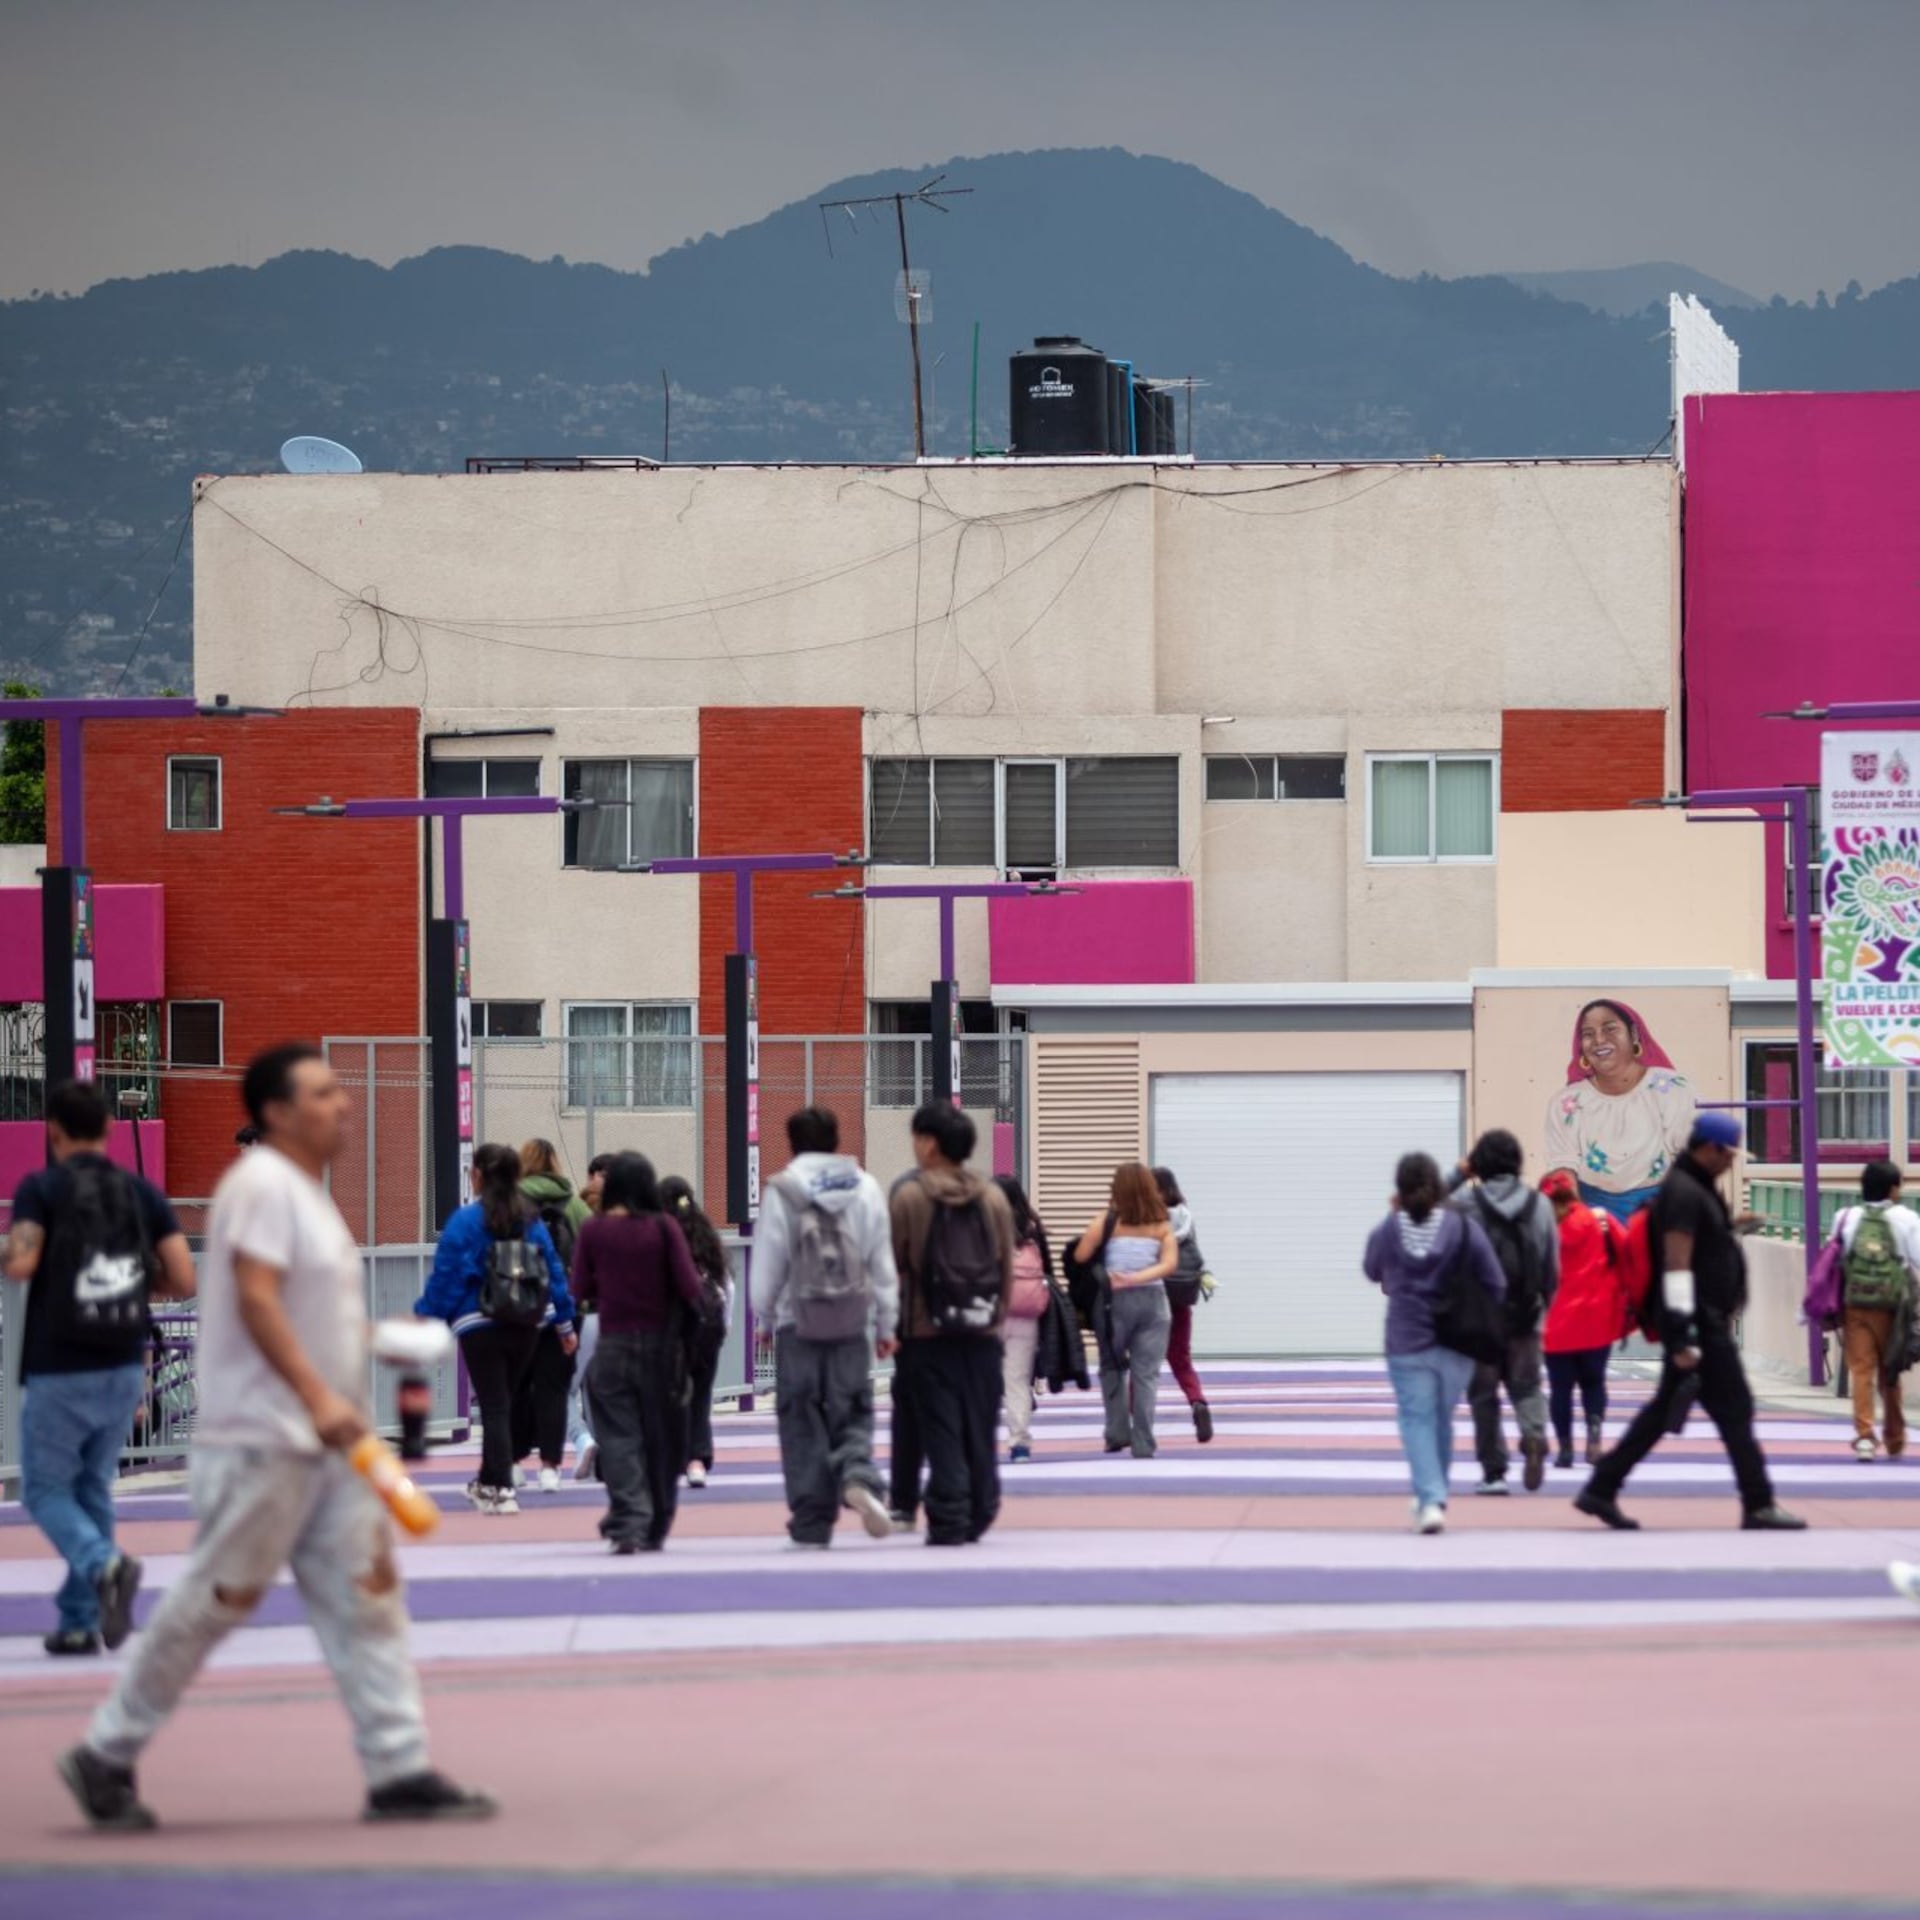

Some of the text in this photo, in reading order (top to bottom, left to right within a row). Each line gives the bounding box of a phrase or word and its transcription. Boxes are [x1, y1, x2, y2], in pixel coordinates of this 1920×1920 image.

[1831, 790, 1894, 799] GOBIERNO
[1898, 790, 1913, 798] DE
[1831, 801, 1872, 809] CIUDAD
[1875, 801, 1889, 809] DE
[1836, 985, 1920, 1001] LA PELOT
[1836, 1004, 1920, 1016] VUELVE A CAS
